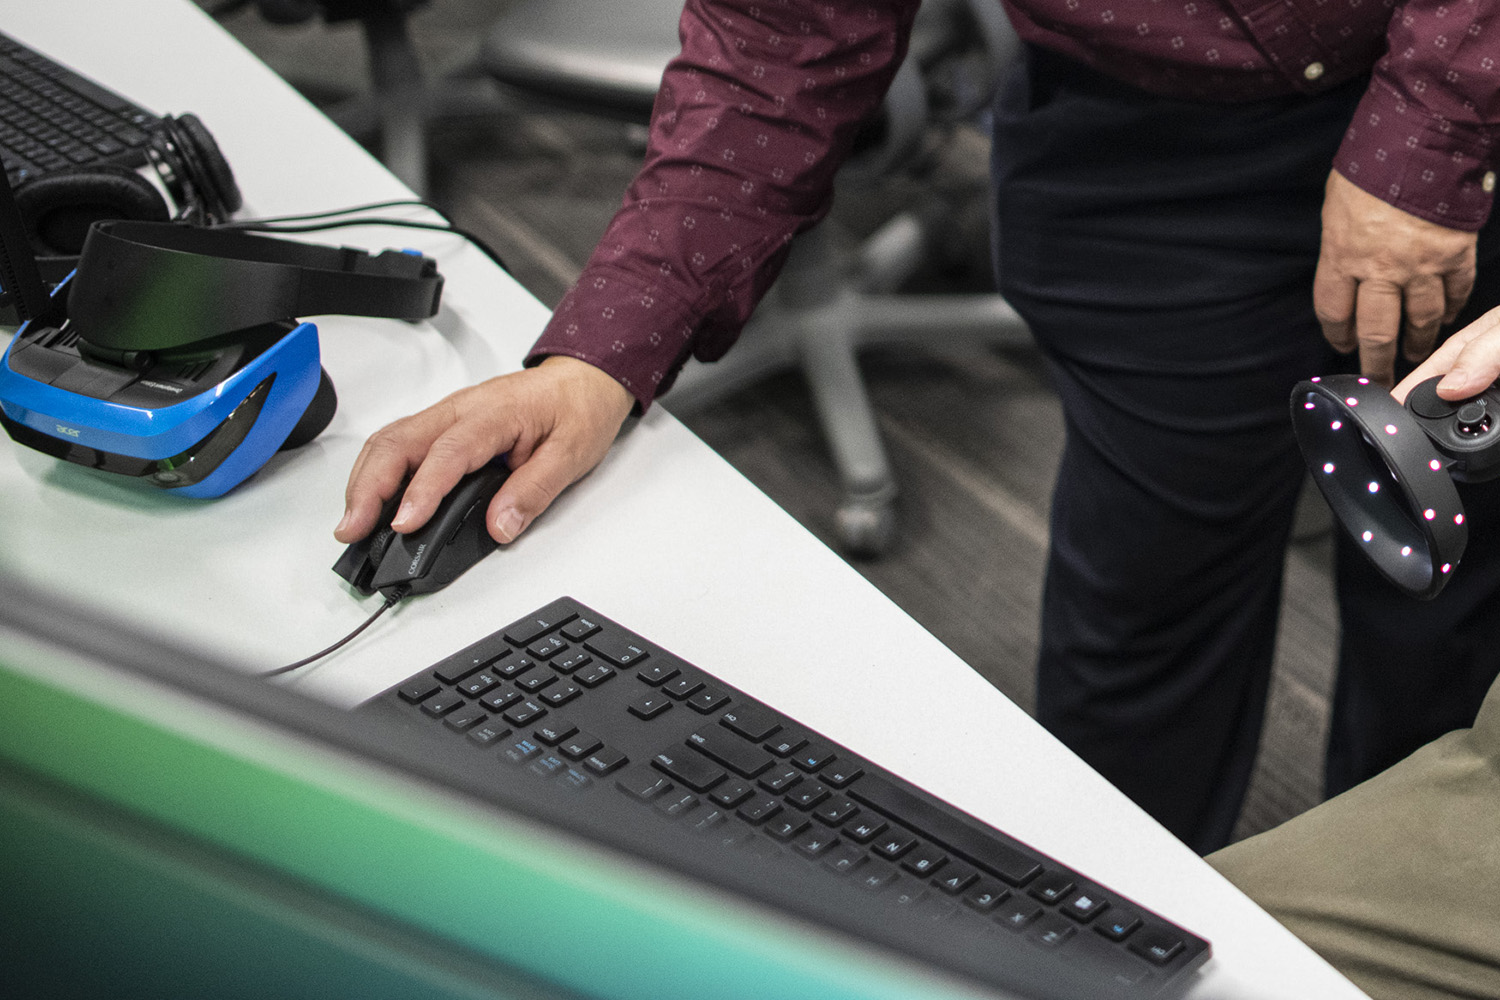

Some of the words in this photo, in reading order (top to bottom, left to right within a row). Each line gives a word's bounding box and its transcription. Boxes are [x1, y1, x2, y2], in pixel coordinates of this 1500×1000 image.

[56, 424, 81, 438] acer
[408, 543, 427, 575] CORSAIR
[725, 713, 737, 722] Ctrl
[691, 733, 706, 744] Shift
[658, 754, 673, 765] Enter
[782, 823, 791, 833] L
[856, 825, 870, 835] M
[808, 841, 821, 850] K
[886, 842, 900, 851] N
[917, 860, 929, 869] B
[947, 877, 959, 886] V
[978, 894, 991, 904] C
[1011, 912, 1024, 923] X
[1042, 931, 1058, 942] Z
